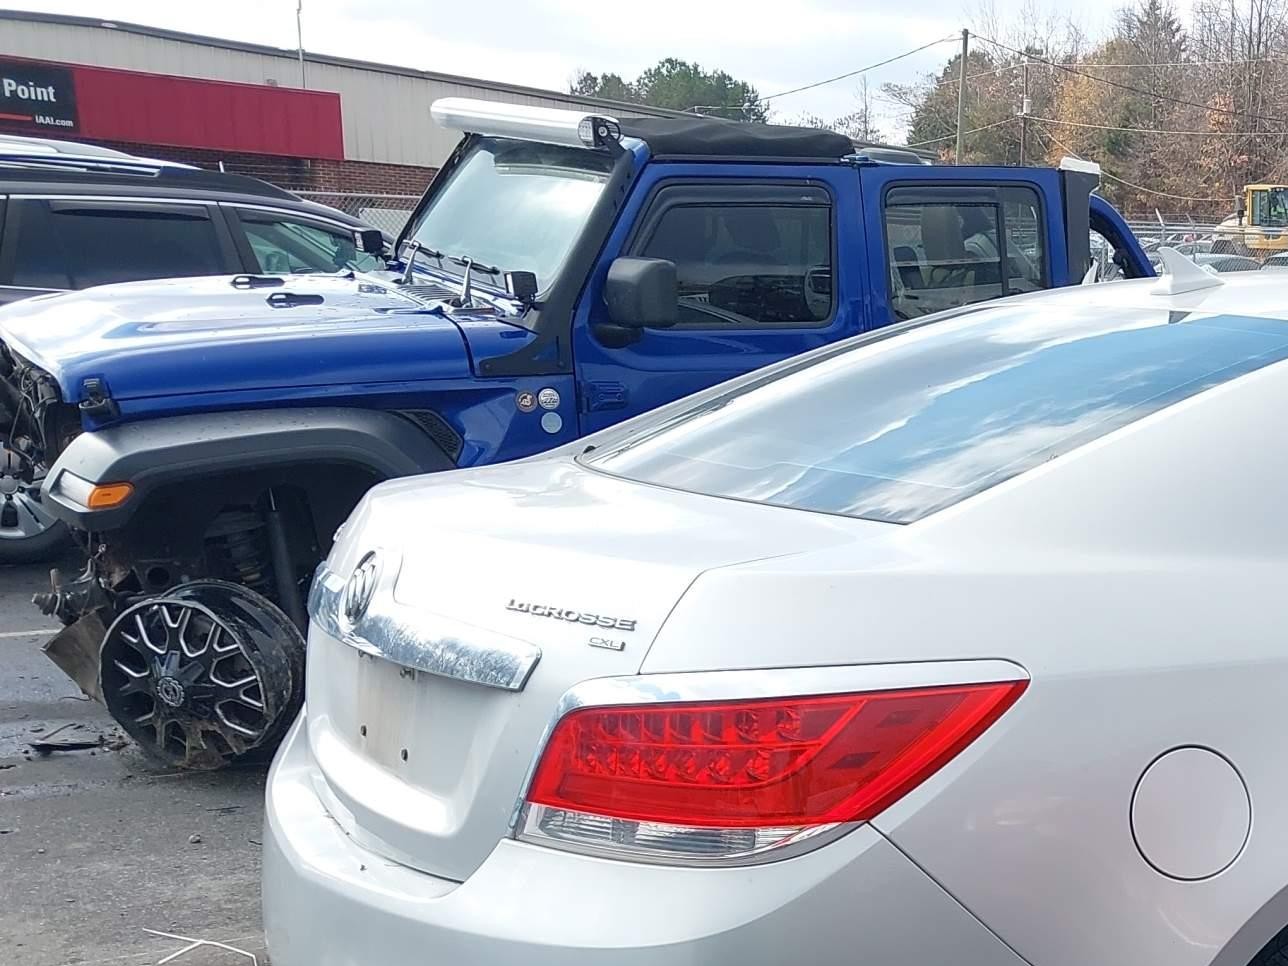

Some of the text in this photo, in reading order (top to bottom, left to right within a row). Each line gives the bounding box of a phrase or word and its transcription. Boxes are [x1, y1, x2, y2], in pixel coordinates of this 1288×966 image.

[3, 78, 56, 102] Point
[35, 115, 74, 127] IAAI.com
[588, 637, 626, 651] CXL
